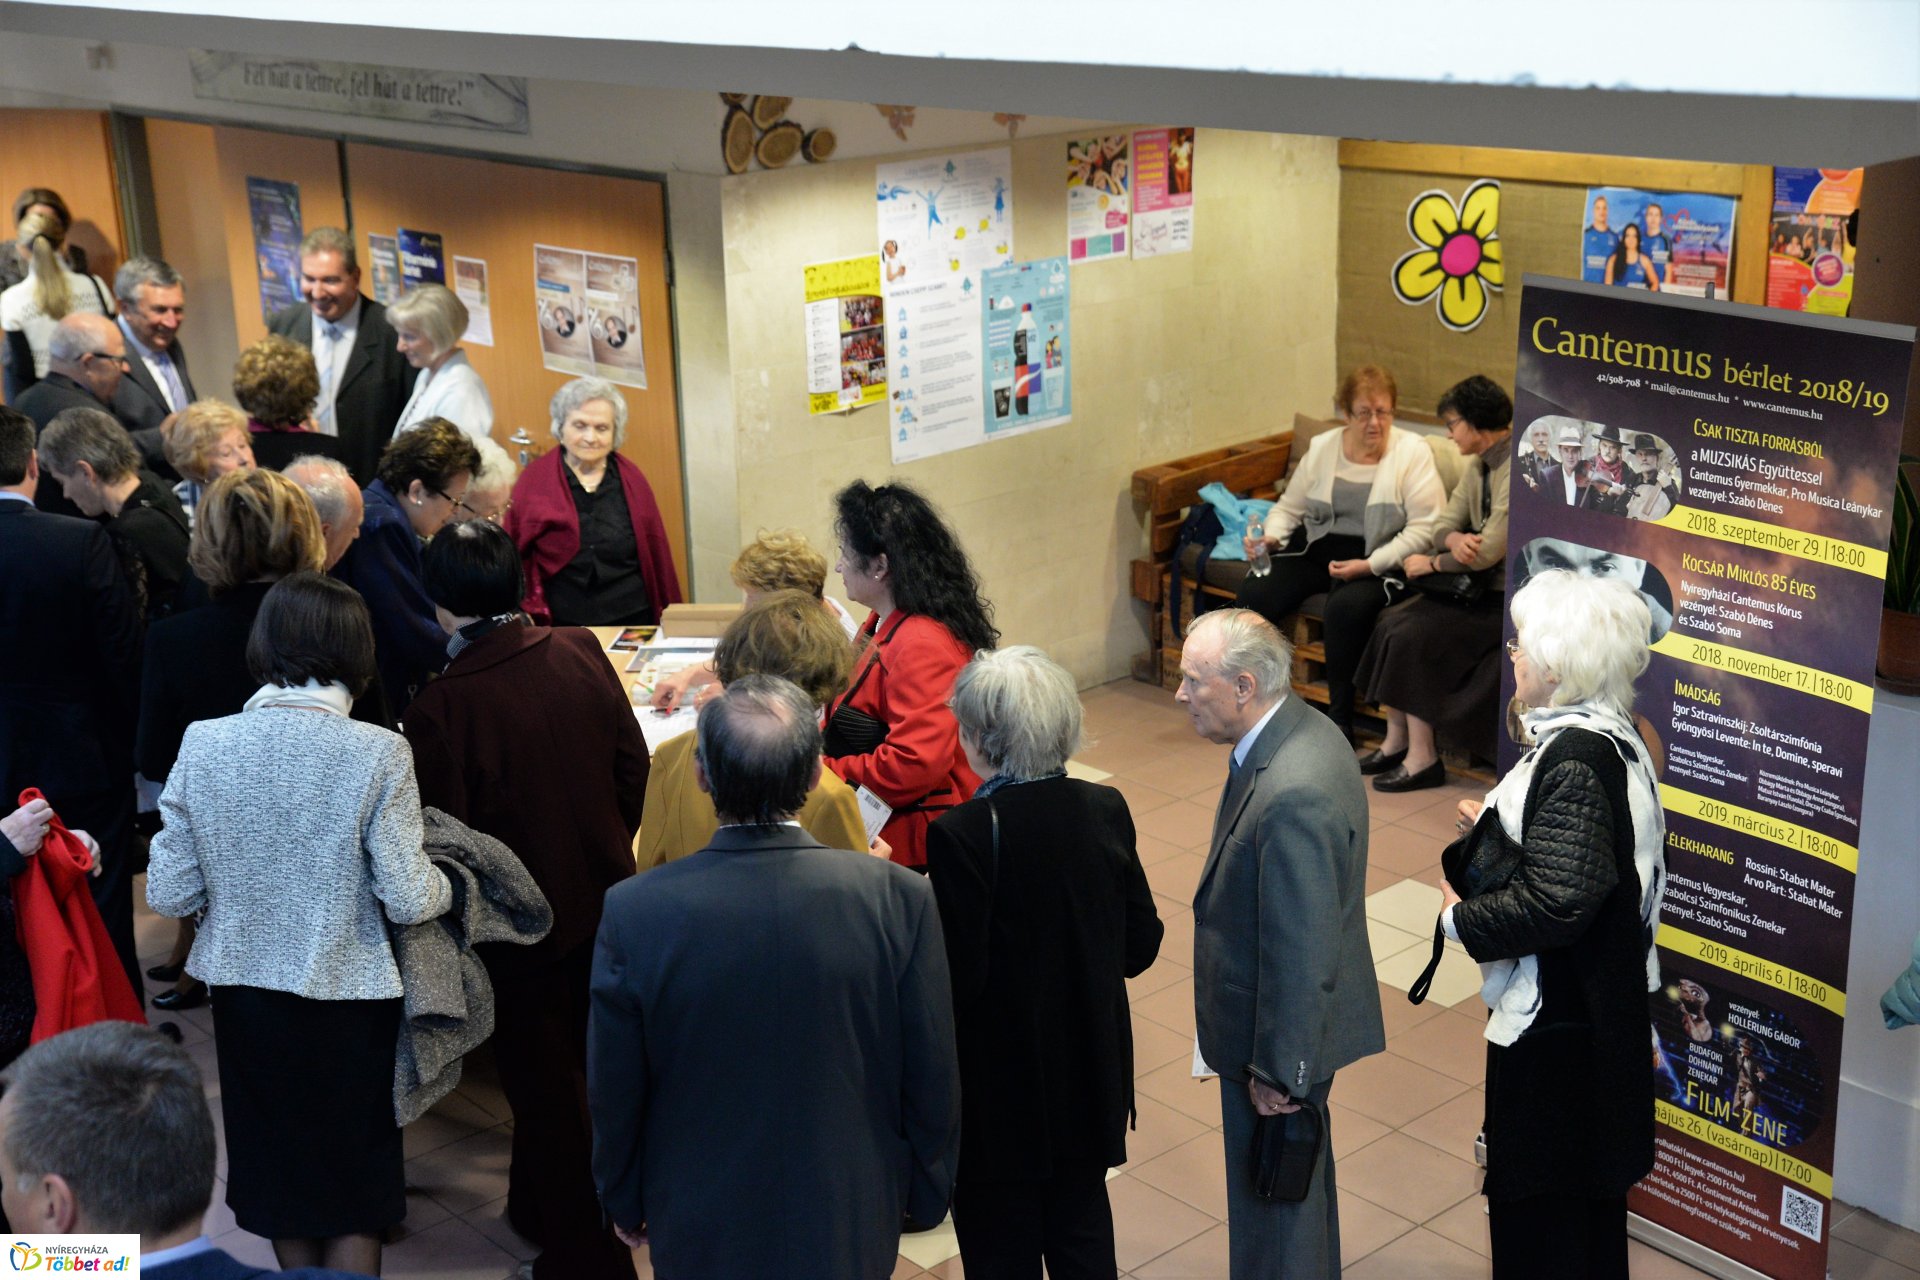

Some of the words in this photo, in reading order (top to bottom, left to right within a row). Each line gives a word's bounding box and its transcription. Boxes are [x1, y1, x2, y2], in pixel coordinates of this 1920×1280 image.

[1531, 316, 1712, 379] Cantemus
[1723, 358, 1792, 394] bérlet
[1799, 380, 1890, 417] 2018/19
[1596, 373, 1641, 388] 42/508-708
[1650, 380, 1730, 404] mail@cantemus.hu
[1743, 399, 1823, 421] www.cantemus.hu
[1694, 418, 1722, 439] CSAK
[1725, 426, 1759, 446] TISZTA
[1763, 433, 1824, 459] FORRÁSBÓL
[1691, 450, 1697, 460] a
[1700, 447, 1756, 472] MUZSIKÁS
[1759, 458, 1822, 485] Együttessel
[1689, 486, 1727, 503] vezényel:
[1729, 491, 1755, 508] Szabó
[1757, 497, 1783, 514] Dénes
[1690, 466, 1733, 486] Cantemus
[1735, 475, 1789, 499] Gyermekkar,
[1791, 487, 1806, 501] Pro
[1808, 490, 1839, 508] Musica
[1842, 498, 1882, 518] Leánykar
[1688, 512, 1718, 534] 2018.
[1722, 524, 1801, 551] szeptember
[1803, 537, 1821, 557] 29.
[1832, 544, 1865, 567] 18:00
[1683, 552, 1724, 577] KOCSÁR
[1727, 562, 1768, 587] MIKLÓS
[1771, 573, 1787, 592] 85
[1790, 578, 1815, 599] ÉVES
[1680, 599, 1718, 616] vezényel:
[1719, 605, 1745, 622] Szabó
[1747, 612, 1773, 629] Dénes
[1681, 579, 1730, 601] Nyíregyházi
[1732, 591, 1775, 612] Cantemus
[1777, 602, 1802, 619] Kórus
[1678, 613, 1688, 625] és
[1689, 615, 1715, 632] Szabó
[1717, 621, 1741, 638] Soma
[1675, 679, 1720, 705] IMÁDSÁG
[1693, 643, 1723, 665] 2018.
[1728, 656, 1792, 682] november
[1796, 670, 1810, 688] 17.
[1820, 677, 1852, 701] 18:00
[1672, 716, 1714, 738] Gyöngyösi
[1716, 729, 1750, 749] Levente:
[1752, 739, 1761, 751] In
[1763, 743, 1773, 757] te,
[1776, 745, 1810, 768] Domine,
[1812, 760, 1842, 777] speravi
[1673, 701, 1690, 716] Igor
[1691, 706, 1748, 734] Sztravinszkij:
[1749, 721, 1822, 753] Zsoltárszimfónia
[1667, 832, 1733, 864] ÉLEKHARANG
[1699, 800, 1729, 823] 2019.
[1733, 815, 1785, 841] március
[1788, 827, 1797, 844] 2.
[1807, 834, 1838, 859] 18:00
[1665, 872, 1702, 891] antemus
[1703, 881, 1747, 907] Vegyeskar,
[1744, 873, 1764, 888] Arvo
[1766, 879, 1786, 896] Pärt:
[1788, 887, 1817, 908] Stabat
[1819, 898, 1842, 918] Mater
[1746, 857, 1777, 877] Rossini:
[1780, 868, 1808, 888] Stabat
[1811, 879, 1835, 898] Mater
[1664, 887, 1698, 905] zabolcsi
[1699, 896, 1750, 923] Szimfonikus
[1752, 913, 1786, 934] Zenekar
[1697, 910, 1721, 928] Szabó
[1723, 920, 1746, 937] Soma
[1700, 941, 1729, 965] 2019.
[1732, 955, 1773, 981] április
[1776, 969, 1786, 985] 6.
[1795, 976, 1826, 1002] 18:00
[1728, 1012, 1773, 1037] HOLLERUNG
[1774, 1030, 1800, 1048] GÁBOR
[1729, 1002, 1759, 1019] vezényel:
[1689, 1054, 1722, 1075] DOHNÁNYI
[1690, 1042, 1722, 1062] BUDAFOKI
[1688, 1066, 1717, 1085] ZENEKAR
[1686, 1117, 1703, 1136] 26.
[1706, 1124, 1773, 1167] (vasárnap)
[1782, 1157, 1811, 1183] 17:00
